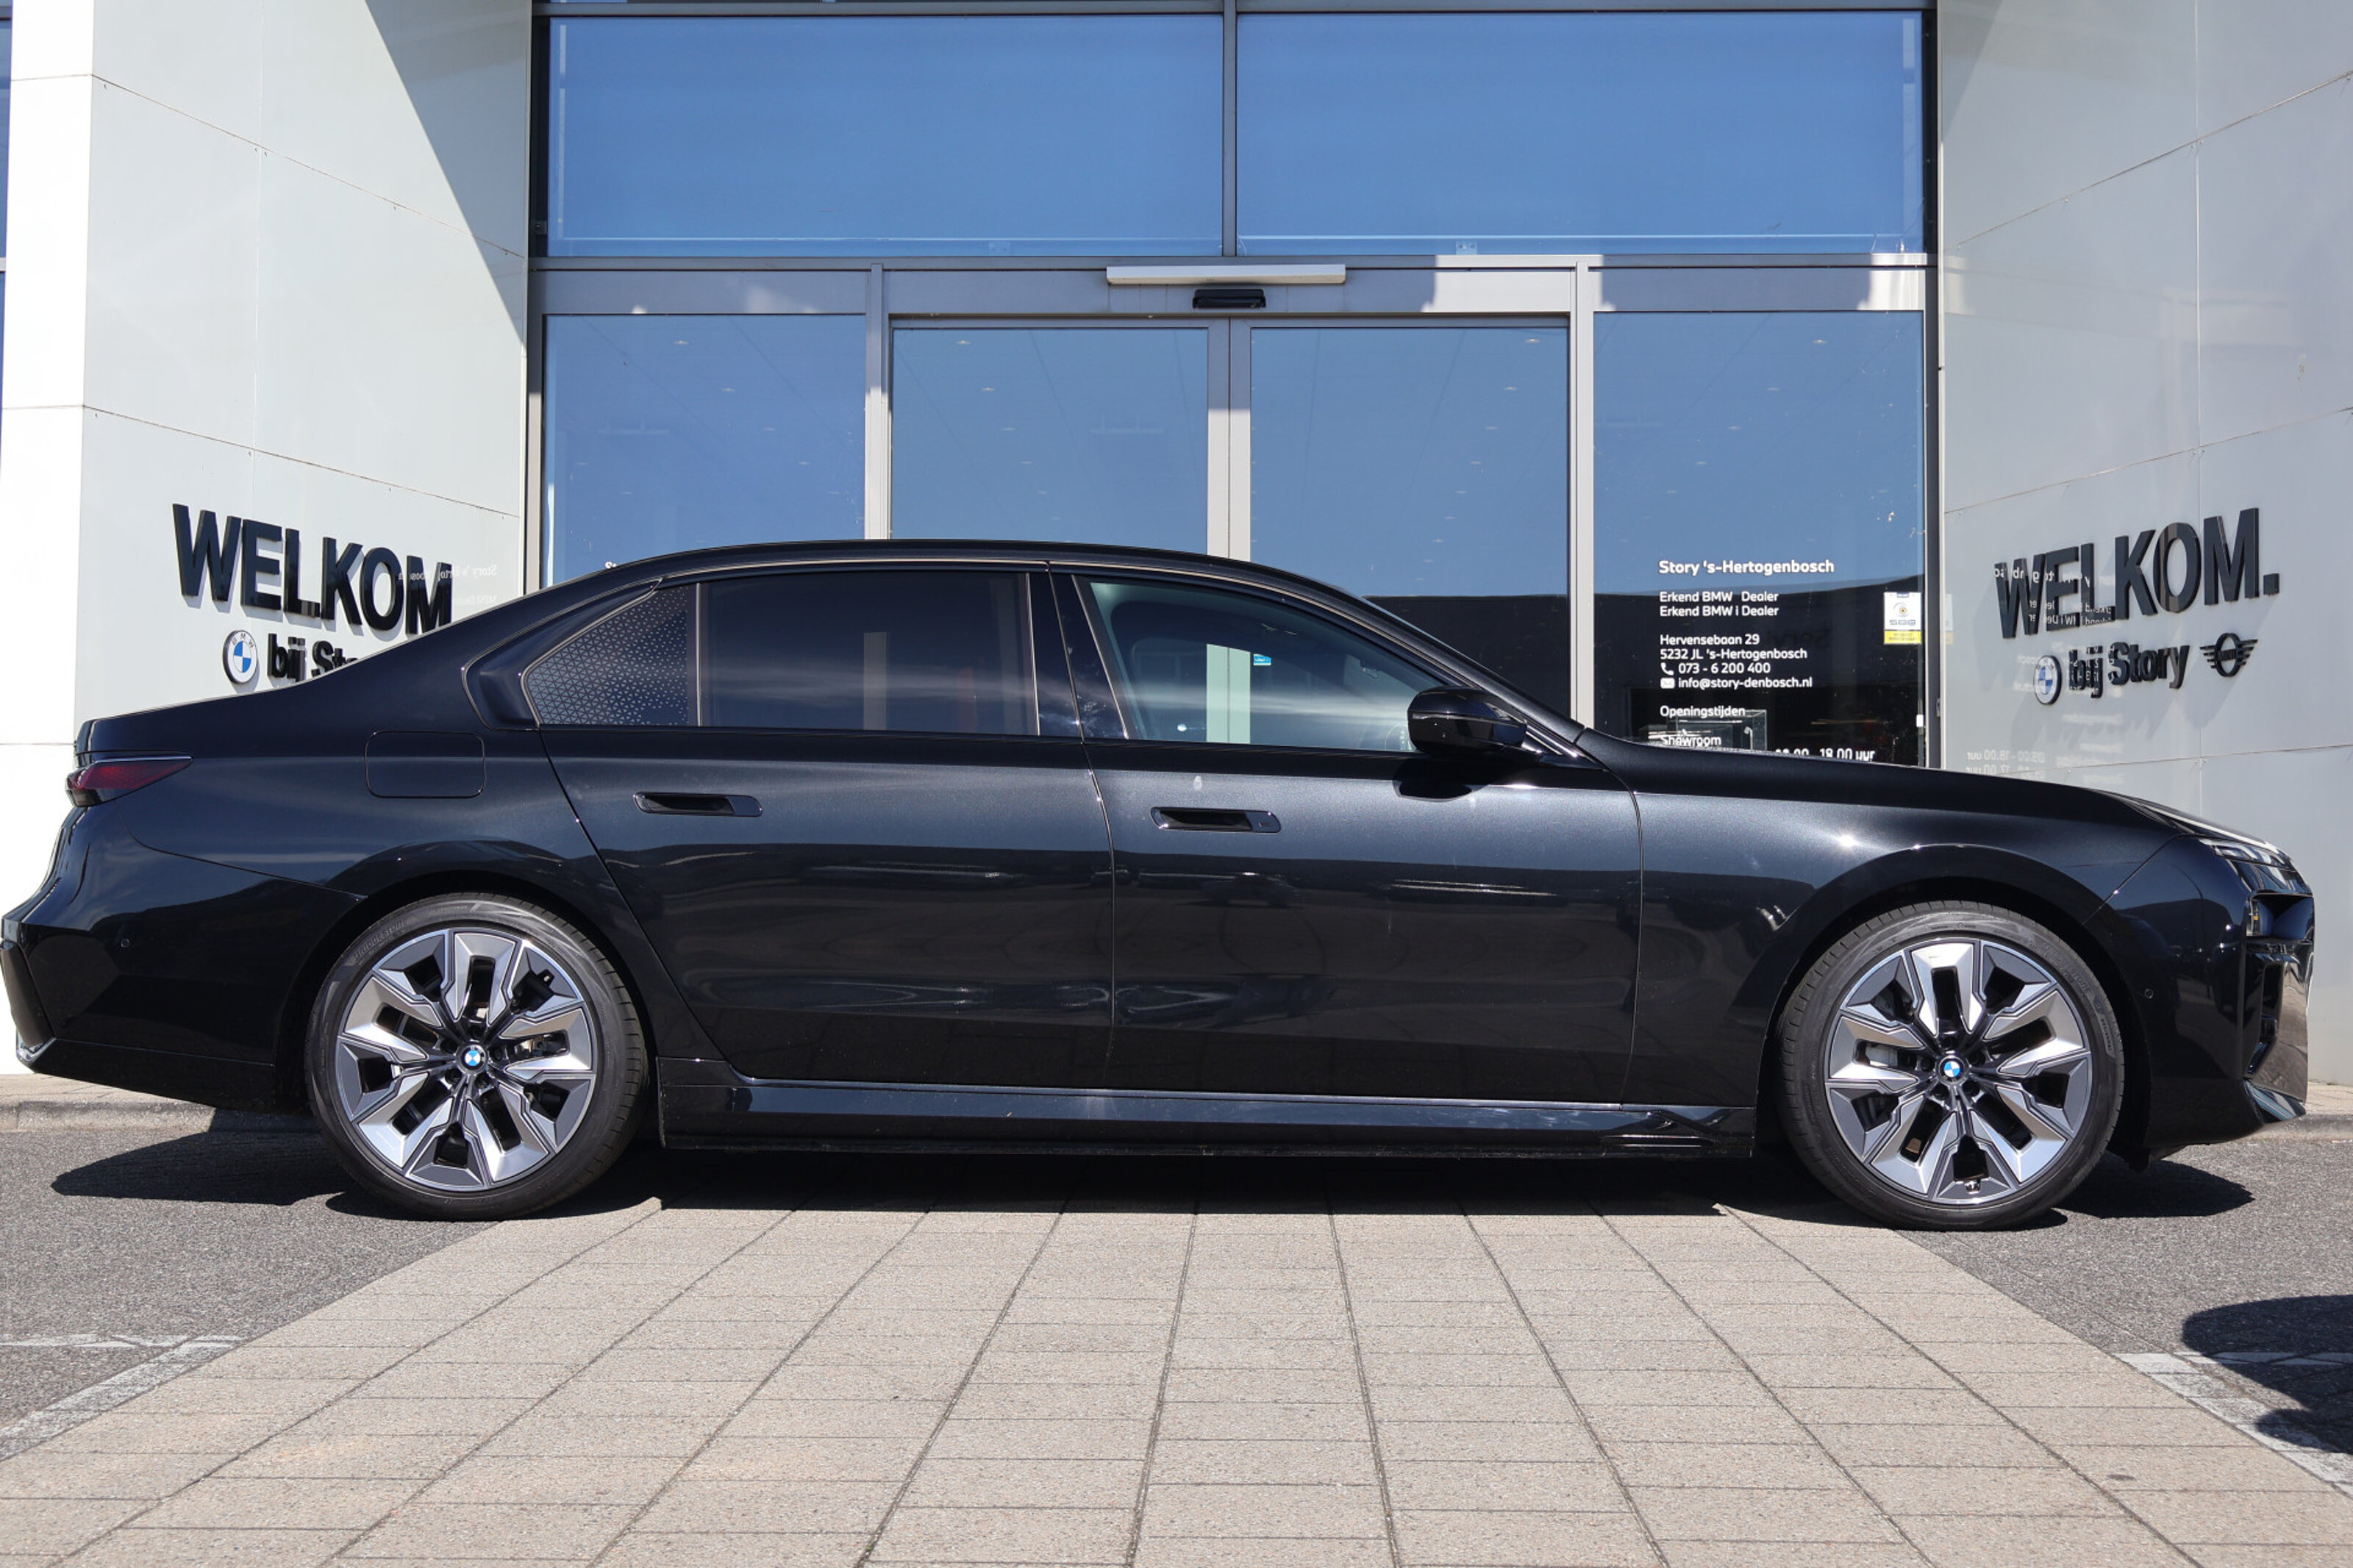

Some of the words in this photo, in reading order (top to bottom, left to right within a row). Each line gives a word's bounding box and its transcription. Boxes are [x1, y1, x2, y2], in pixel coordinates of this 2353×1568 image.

[173, 504, 452, 634] WELKOM
[1660, 561, 1699, 576] Story
[1704, 559, 1835, 576] 's-Hertogenbosch
[1995, 508, 2279, 639] WELKOM.
[1660, 591, 1699, 602] Erkend
[1702, 591, 1733, 602] BMW
[1741, 591, 1779, 602] Dealer
[1660, 605, 1699, 617] Erkend
[1702, 605, 1733, 617] BMW
[1735, 605, 1738, 616] i
[1741, 605, 1779, 617] Dealer
[1660, 634, 1742, 645] Hervensebaan
[1744, 634, 1760, 645] 29
[268, 633, 305, 682] bij
[1660, 648, 1688, 660] 5232
[1690, 648, 1703, 661] JL
[1707, 648, 1807, 661] 's-Hertogenbosch
[1679, 663, 1699, 673] 073
[1711, 663, 1718, 673] 6
[1721, 662, 1744, 673] 200
[1747, 662, 1771, 673] 400
[2069, 645, 2104, 698] bij
[2108, 642, 2190, 689] Story
[1679, 676, 1812, 690] info@story-denbosch.nl
[1660, 705, 1746, 718] Openingstijden
[1660, 735, 1721, 747] Showroom
